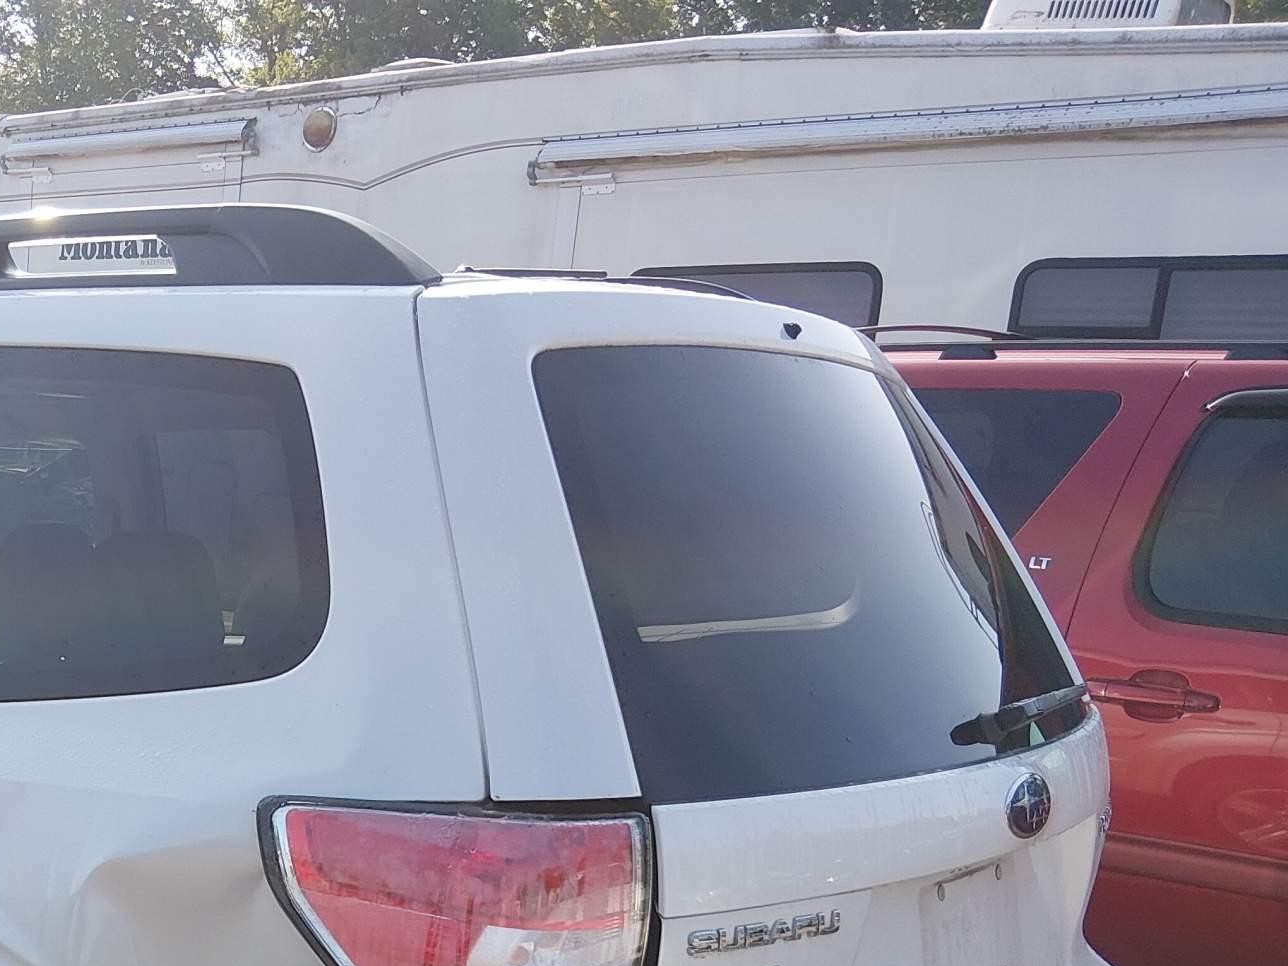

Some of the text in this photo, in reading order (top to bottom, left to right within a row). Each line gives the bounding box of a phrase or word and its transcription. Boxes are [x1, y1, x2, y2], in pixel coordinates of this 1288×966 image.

[59, 239, 173, 261] Montana
[1028, 556, 1052, 570] LT
[687, 909, 840, 956] SUBARU
